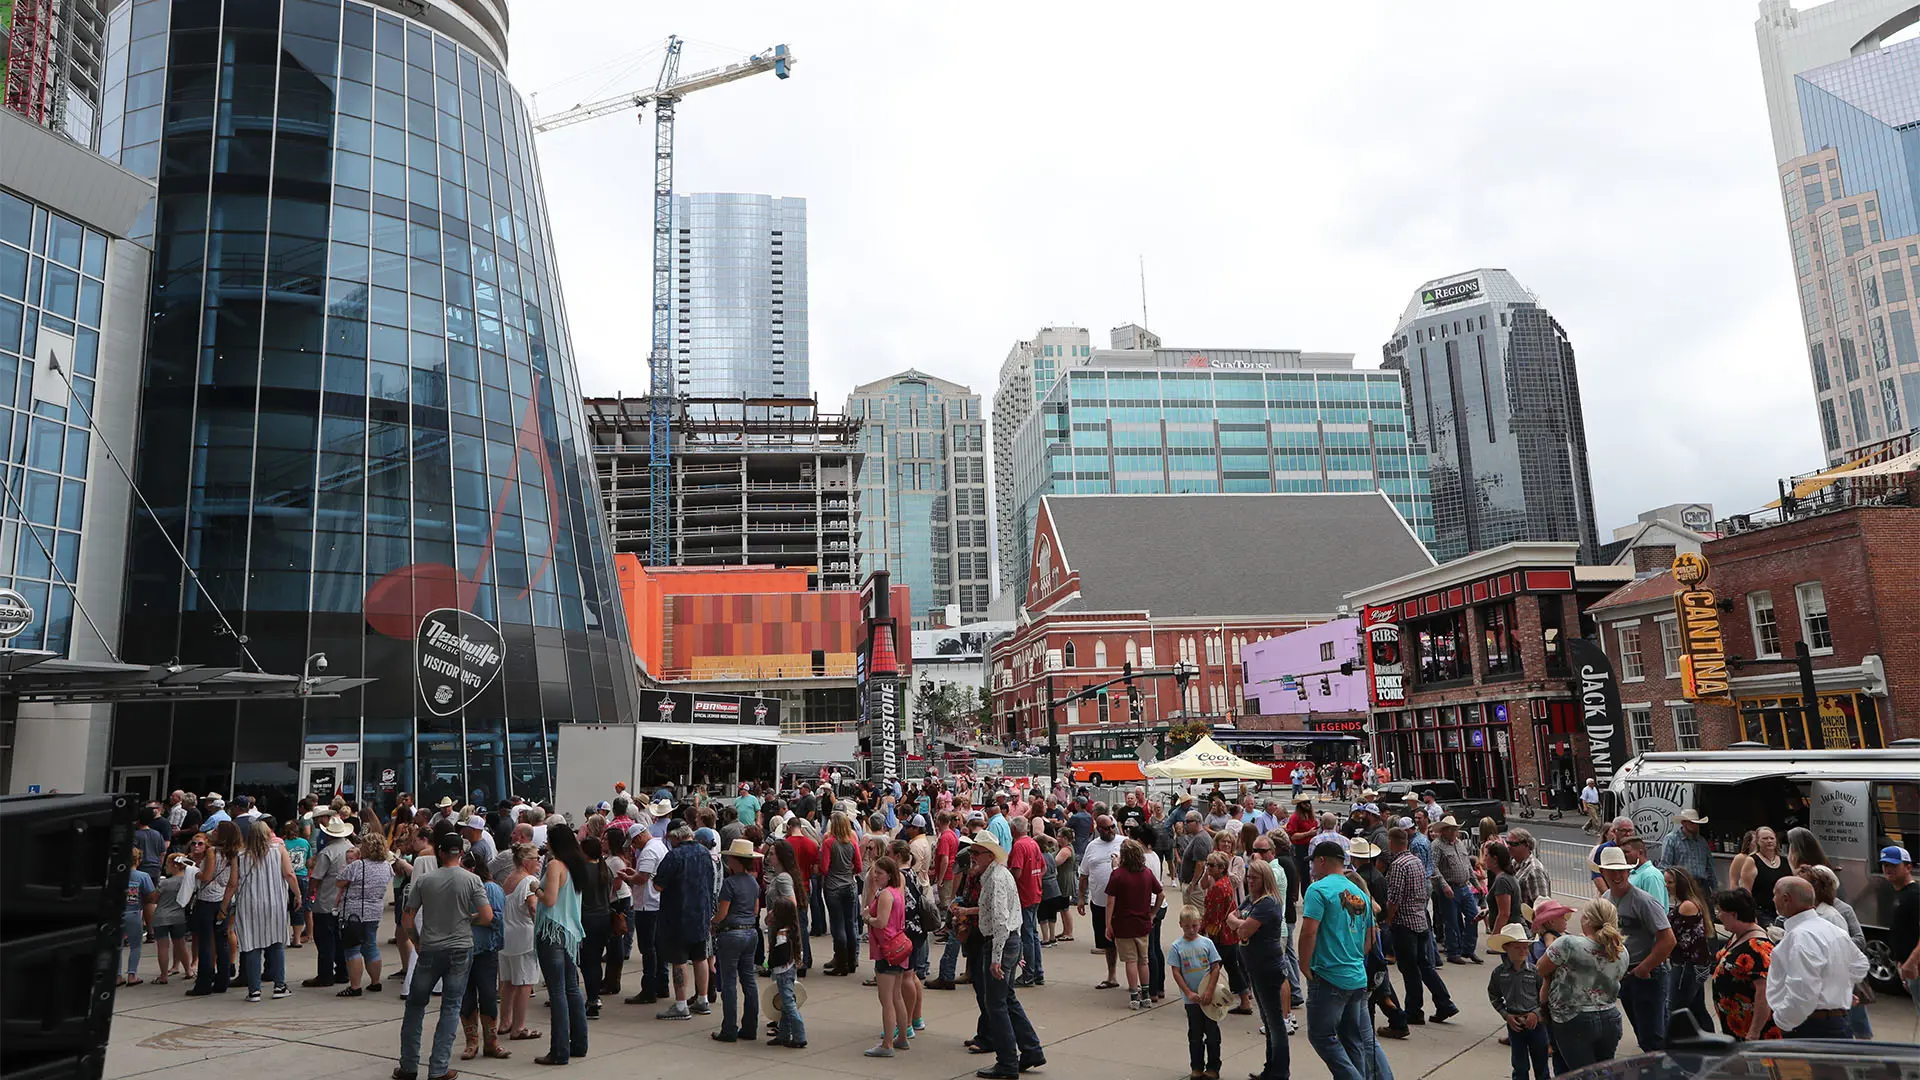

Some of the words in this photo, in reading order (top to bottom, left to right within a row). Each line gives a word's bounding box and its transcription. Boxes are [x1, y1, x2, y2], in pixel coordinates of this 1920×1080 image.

[1435, 281, 1478, 299] REGIONS
[1684, 511, 1708, 523] CMT
[1372, 629, 1399, 642] RIBS
[426, 619, 500, 667] Nashville
[1683, 592, 1729, 695] CANTINA
[434, 641, 460, 655] MUSIC
[464, 654, 481, 665] CITY
[423, 654, 460, 679] VISITOR
[460, 669, 482, 689] INFO
[1375, 676, 1403, 688] HONKY
[1377, 688, 1405, 700] TONK
[1581, 664, 1609, 719] JACK
[1315, 722, 1361, 732] LEGENDS
[1821, 715, 1844, 726] ANCHO
[1197, 752, 1238, 761] Coors
